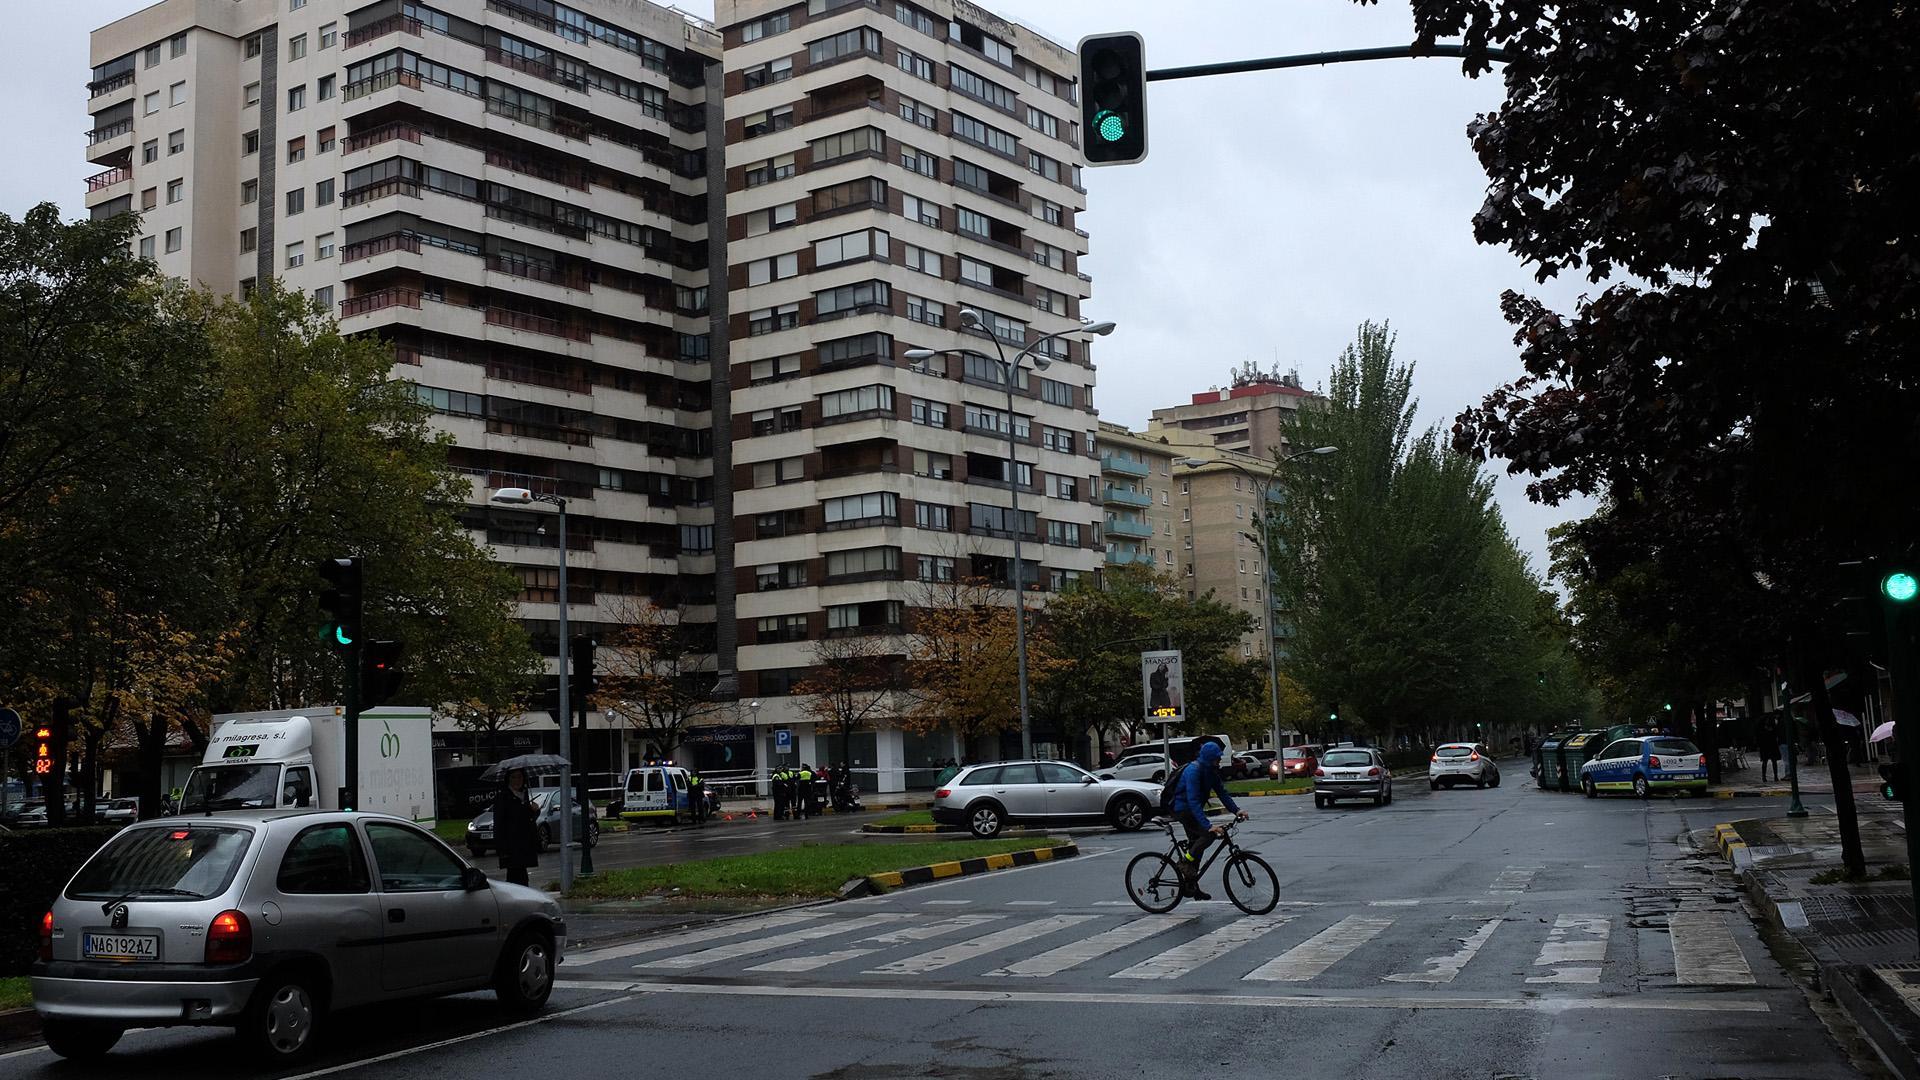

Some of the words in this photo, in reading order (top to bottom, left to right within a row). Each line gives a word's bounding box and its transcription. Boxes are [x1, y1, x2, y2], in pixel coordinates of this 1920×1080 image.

[1145, 657, 1178, 665] MANGO
[211, 736, 220, 744] la
[778, 732, 788, 745] P
[36, 759, 51, 774] 82
[91, 936, 153, 954] NA6192AZ
